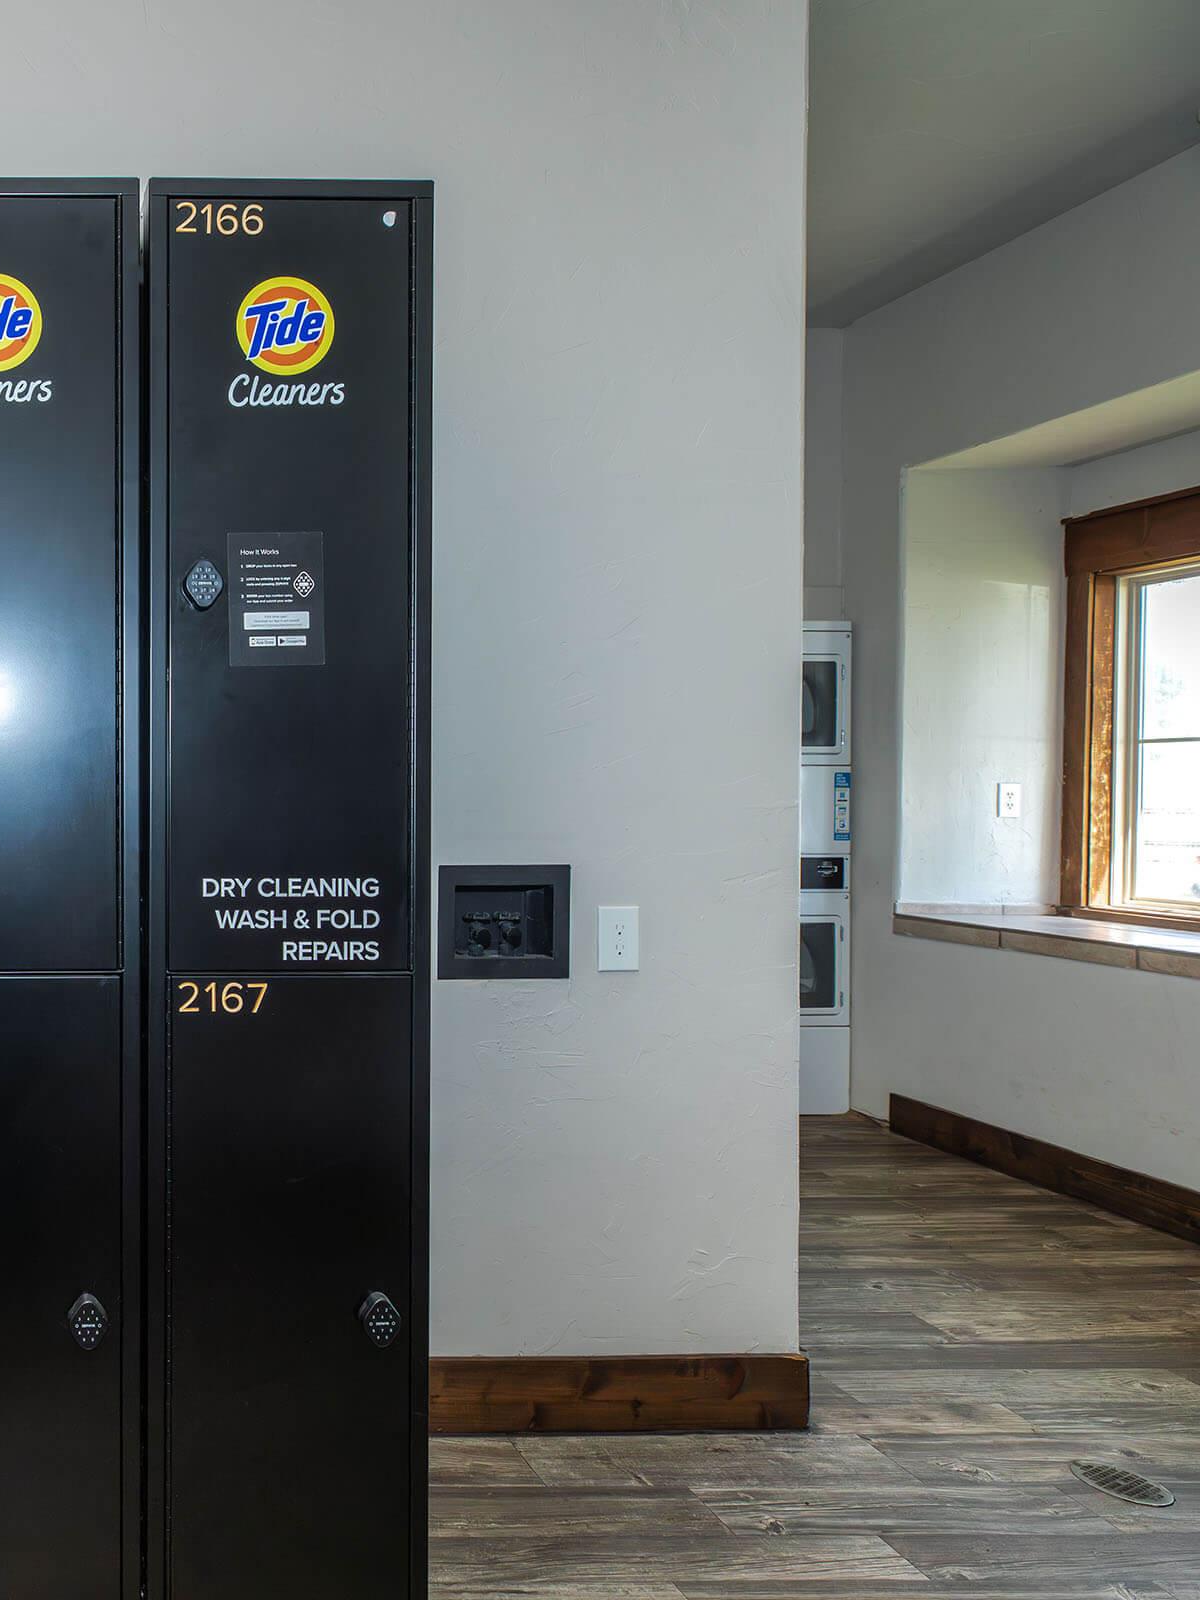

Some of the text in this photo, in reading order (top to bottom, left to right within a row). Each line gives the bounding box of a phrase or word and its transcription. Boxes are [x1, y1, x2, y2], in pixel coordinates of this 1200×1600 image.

[175, 202, 264, 235] 2166
[243, 299, 327, 360] Tide
[227, 372, 345, 408] Cleaners
[260, 548, 279, 556] Works
[202, 877, 380, 898] DRY CLEANING
[215, 909, 380, 929] WASH & FOLD
[282, 941, 380, 961] REPAIRS
[178, 981, 268, 1014] 2167
